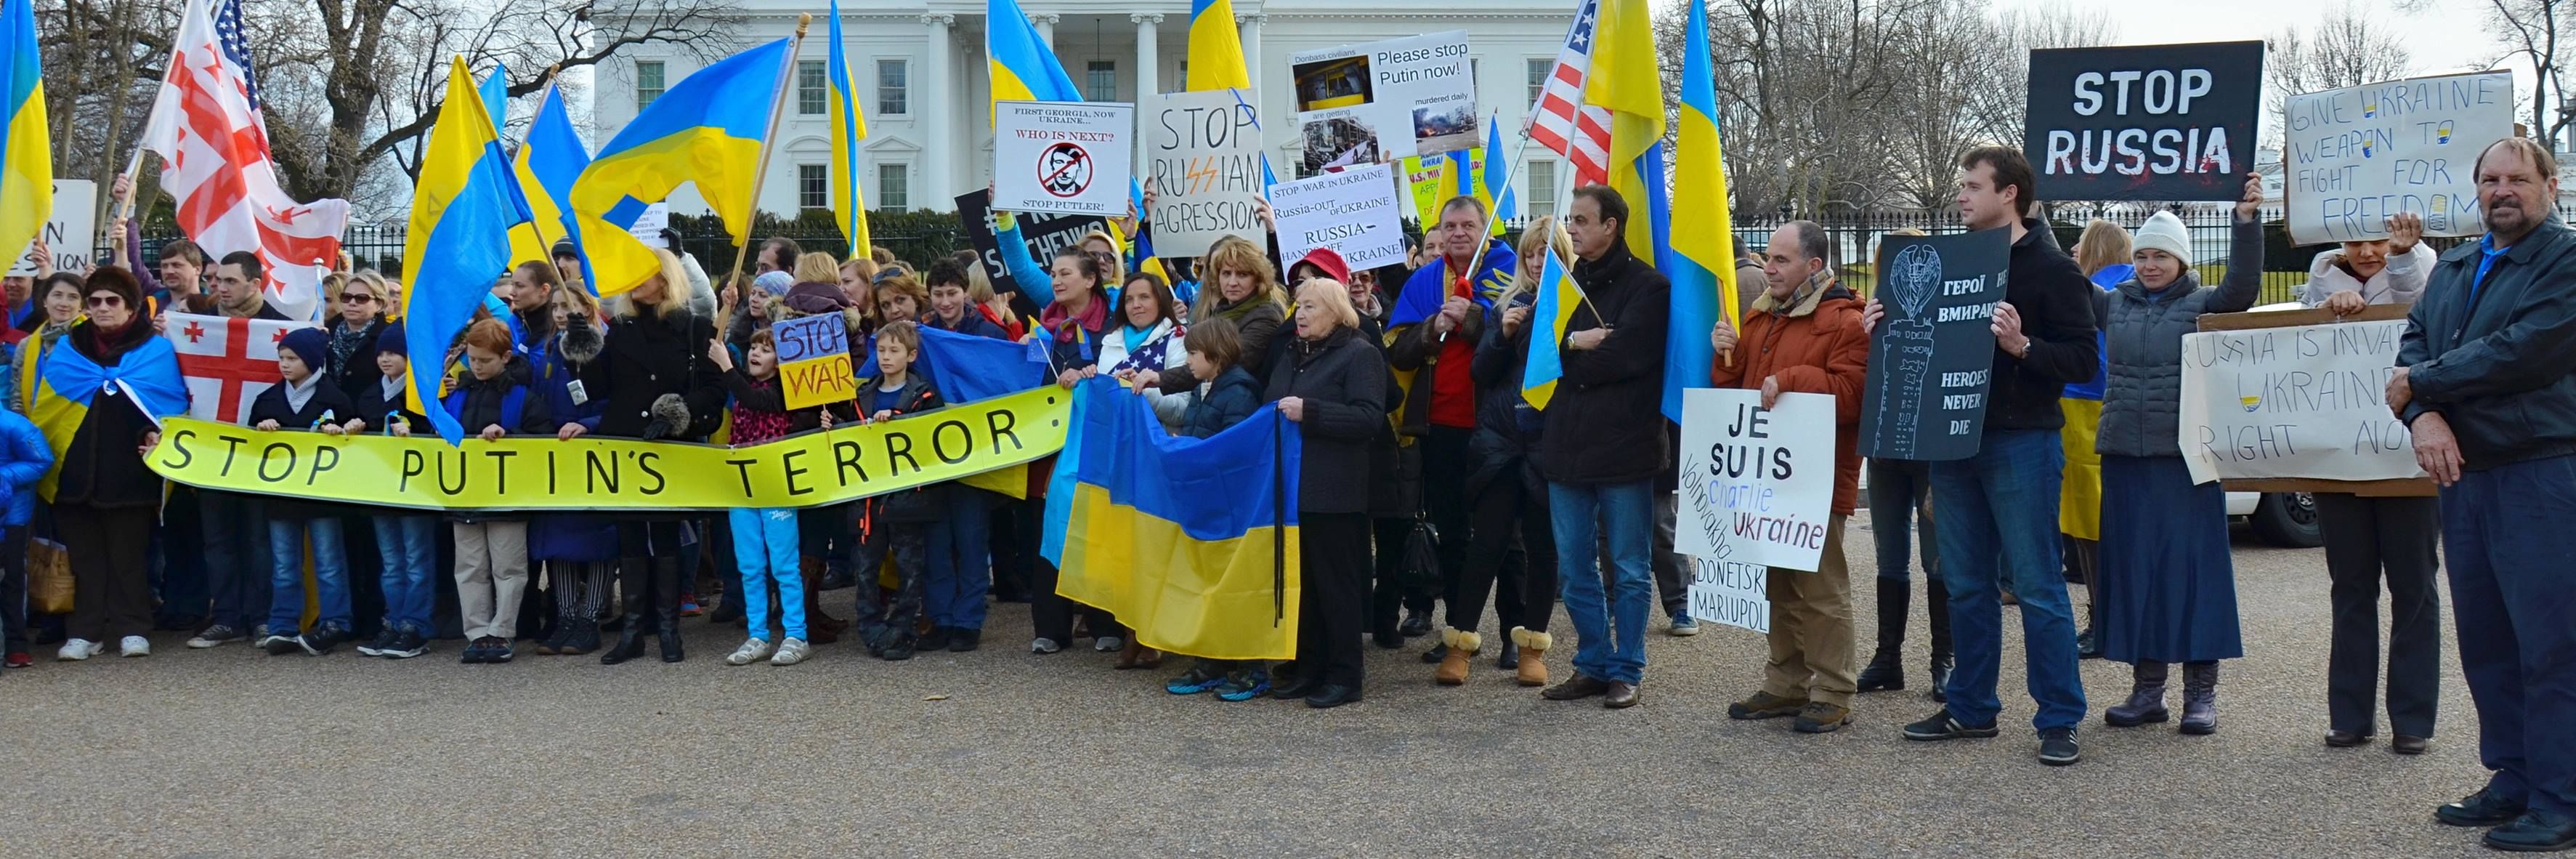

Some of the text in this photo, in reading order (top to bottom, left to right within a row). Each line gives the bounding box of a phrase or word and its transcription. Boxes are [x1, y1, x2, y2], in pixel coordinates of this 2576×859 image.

[1295, 49, 1356, 64] Donbass civilians
[1377, 43, 1468, 65] Please stop
[1380, 62, 1461, 85] Putin now!
[1415, 92, 1468, 105] murdered daily
[2073, 68, 2213, 116] STOP
[2291, 78, 2494, 132] GIVE UKRAINE
[1160, 103, 1257, 150] STOP
[1327, 109, 1350, 120] getting
[1016, 129, 1114, 142] WHO IS NEXT?
[2045, 126, 2232, 175] RUSSIA
[2295, 119, 2454, 164] WEAPON TO
[1275, 186, 1299, 198] STOP
[1303, 181, 1326, 192] WAR
[1339, 169, 1384, 185] UKRAINE
[2298, 158, 2451, 193] FIGHT FOR
[1023, 200, 1104, 211] STOP PUTLER!
[1154, 201, 1262, 235] AGRESSION
[1273, 199, 1337, 219] Russia-OUT
[1339, 196, 1390, 214] UKRAINE
[1281, 246, 1319, 262] HAND
[1943, 275, 1986, 296] ГЕРОЇ
[1937, 299, 2004, 323] ВМИРАЮ
[779, 314, 845, 362] STOP
[2296, 328, 2320, 360] IS
[785, 356, 856, 398] WAR
[1941, 368, 1988, 387] HEROES
[1943, 392, 1982, 410] NEVER
[1728, 403, 1771, 439] JE
[1949, 419, 1971, 435] DIE
[2199, 424, 2298, 464] RIGHT
[162, 430, 340, 486] STOP
[399, 448, 666, 496] PUTIN'S
[1709, 442, 1793, 481] SUIS
[1709, 479, 1773, 512] Charlie
[1734, 511, 1825, 550] Ukraine
[1696, 557, 1766, 596] DONETSK
[1694, 589, 1767, 632] MARIUPOL
